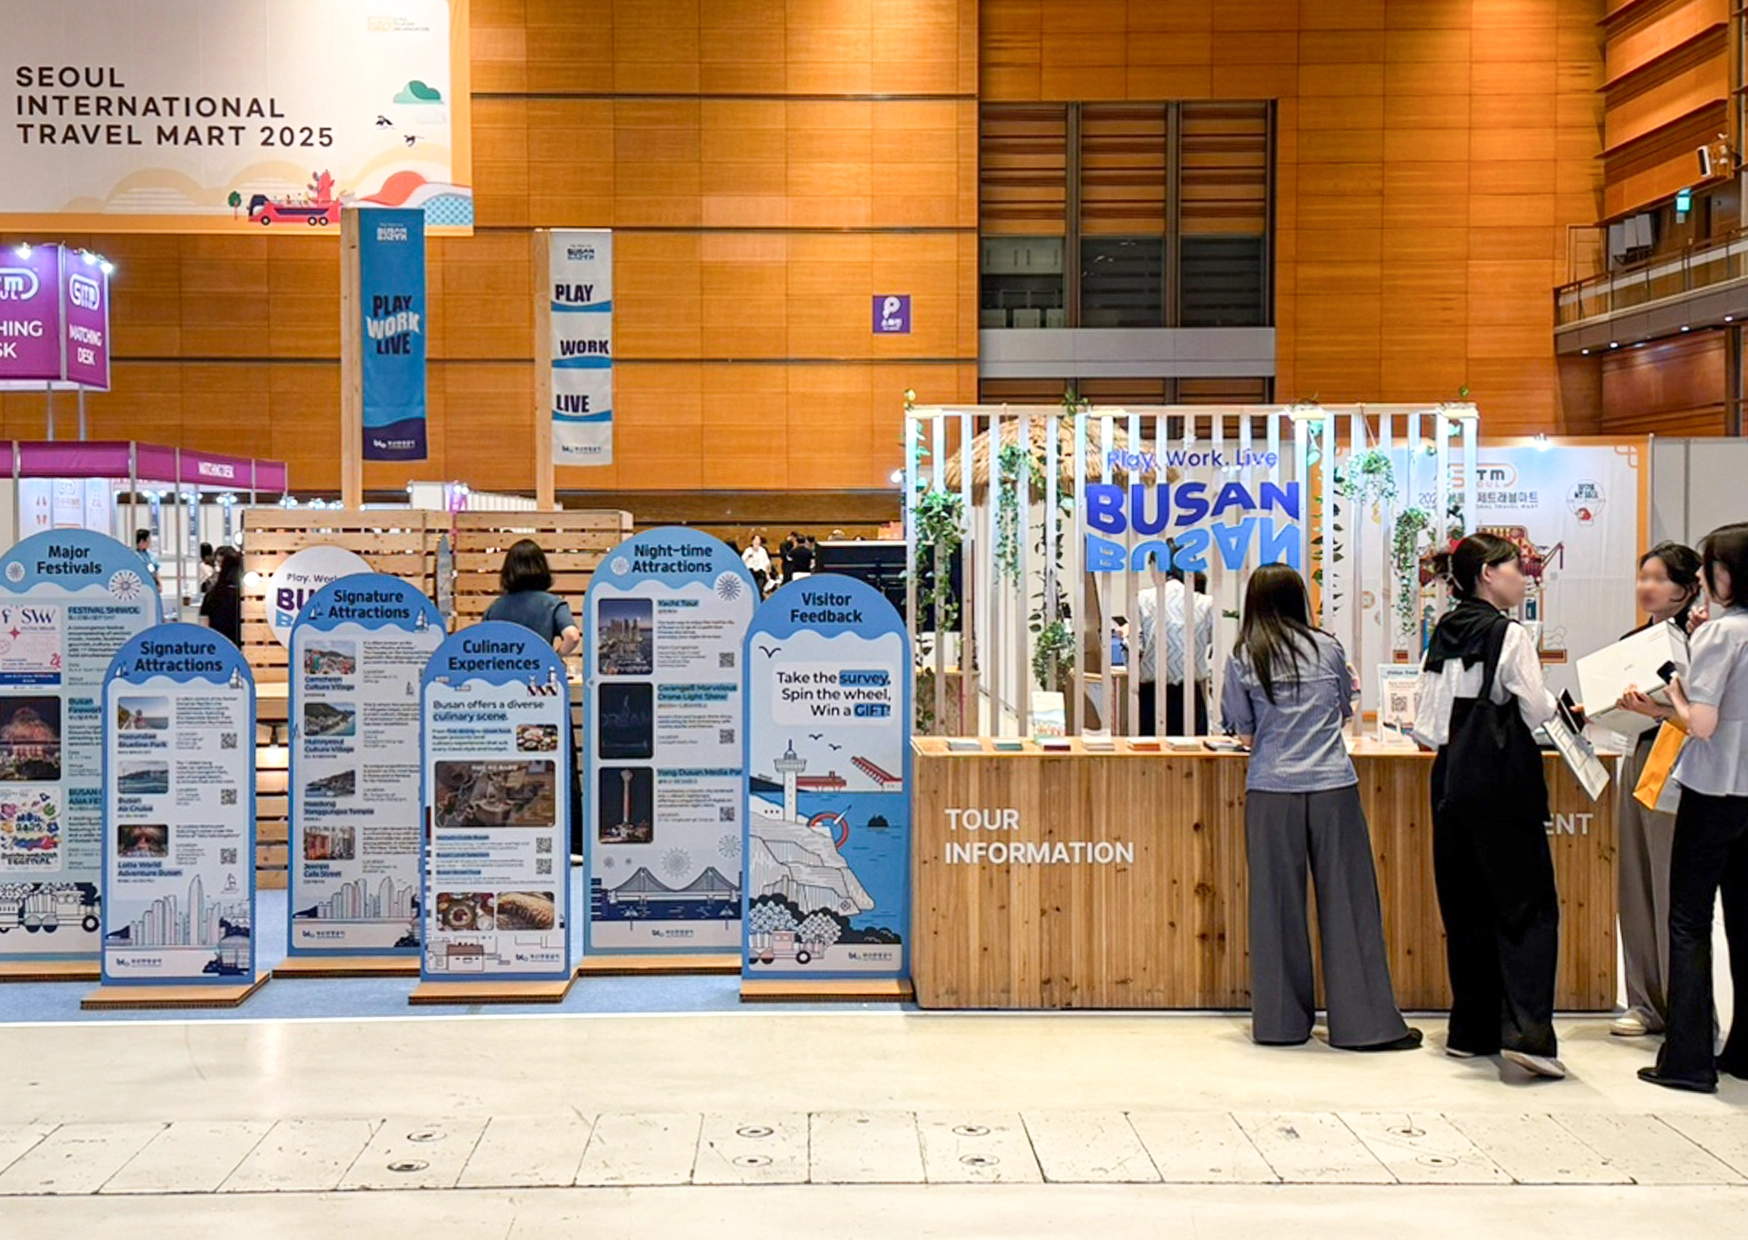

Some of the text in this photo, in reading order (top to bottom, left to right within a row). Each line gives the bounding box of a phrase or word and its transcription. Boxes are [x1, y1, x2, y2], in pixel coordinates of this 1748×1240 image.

[16, 66, 125, 88] SEOUL
[16, 95, 285, 118] INTERNATIONAL
[17, 124, 334, 147] TRAVEL MART 2025
[555, 284, 594, 302] PLAY
[373, 295, 412, 318] PLAY
[366, 311, 421, 339] WORK
[377, 333, 411, 355] LIVE
[560, 340, 609, 356] WORK
[556, 395, 589, 413] LIVE
[1166, 450, 1229, 466] Work.
[1236, 449, 1278, 467] Live
[1086, 482, 1300, 535] BUSAN
[48, 546, 90, 560] Major
[634, 544, 713, 559] Night-time
[37, 562, 102, 575] Festivals
[632, 560, 713, 573] Attractions
[334, 589, 404, 605] Signature
[802, 592, 852, 606] Visitor
[328, 606, 410, 619] Attractions
[790, 609, 863, 623] Feedback
[140, 641, 216, 657] Signature
[463, 640, 525, 655] Culinary
[134, 658, 223, 672] Attractions
[448, 657, 540, 672] Experiences
[777, 672, 891, 687] Take the survey,
[782, 689, 891, 702] Spin the wheel,
[433, 700, 465, 709] Busan
[467, 700, 497, 709] offers
[507, 700, 544, 709] diverse
[811, 703, 891, 717] Win a GIFT!
[433, 711, 509, 723] culinary scene.
[944, 808, 1020, 831] TOUR
[945, 842, 1134, 864] INFORMATION
